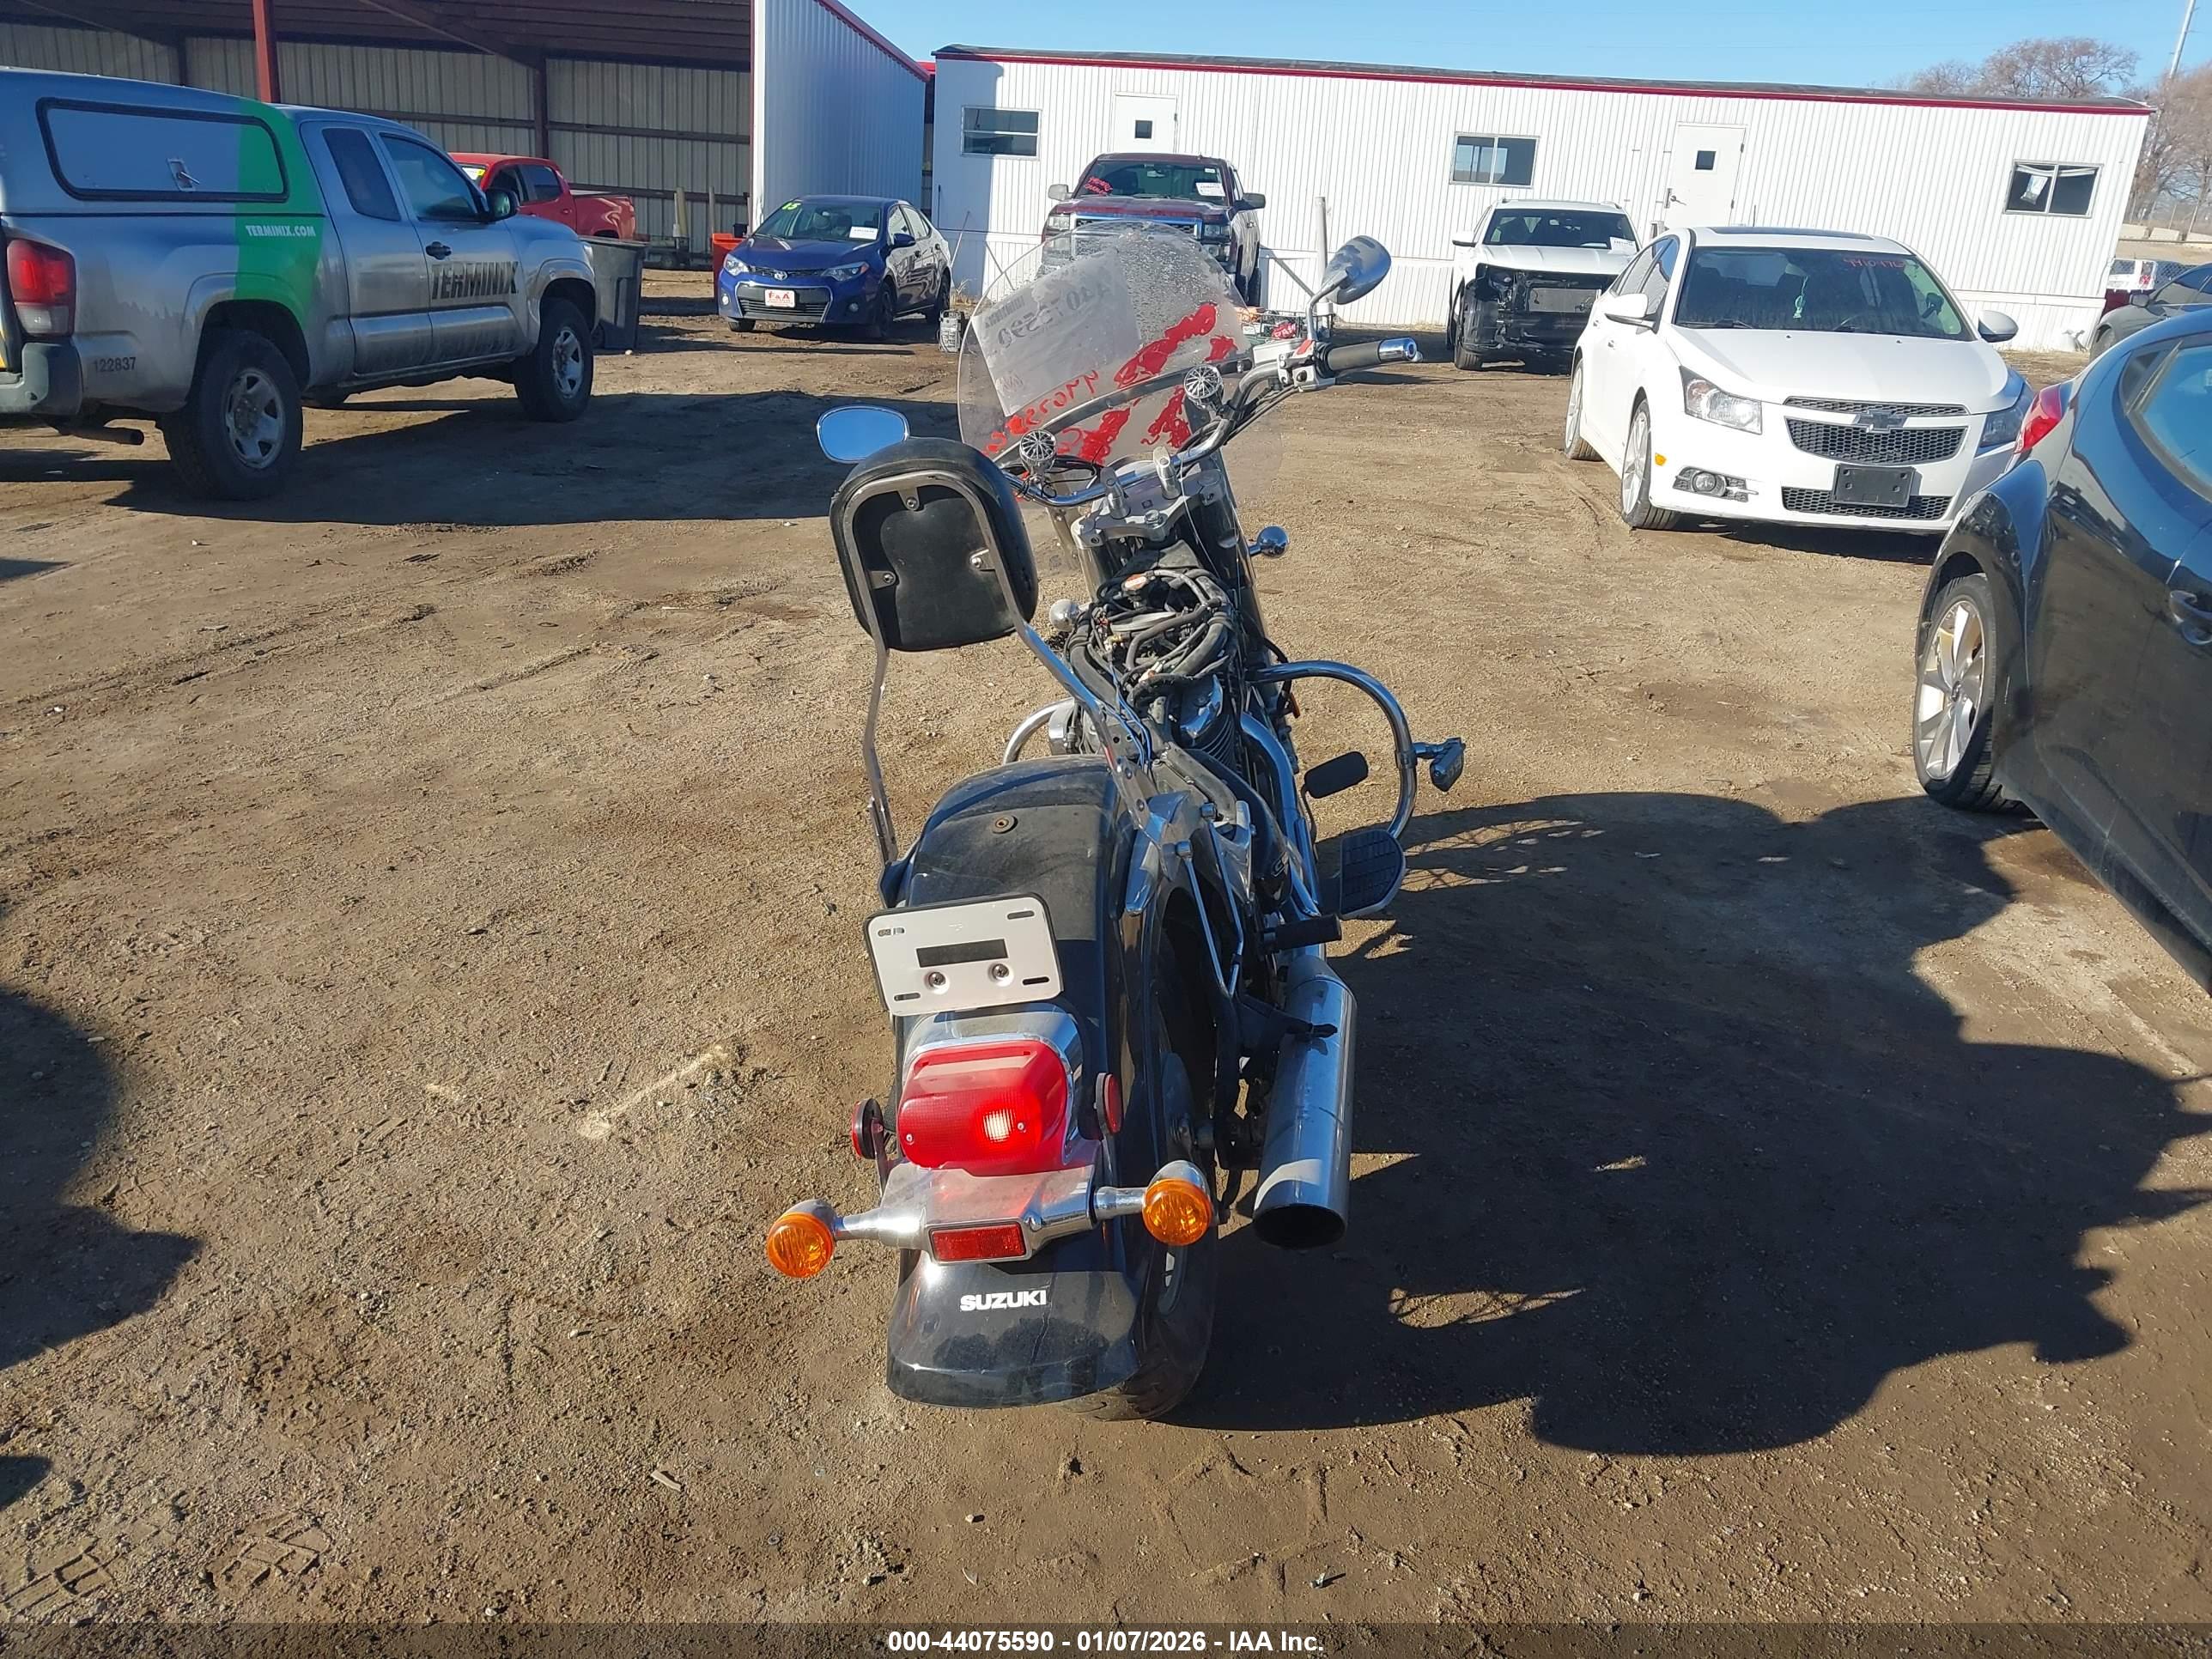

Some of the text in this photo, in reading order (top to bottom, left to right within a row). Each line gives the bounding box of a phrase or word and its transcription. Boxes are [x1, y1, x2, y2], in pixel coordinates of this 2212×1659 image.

[245, 224, 317, 237] TERMINIX.COM
[431, 261, 520, 300] TERMINIX
[93, 356, 137, 373] 122837
[959, 1289, 1047, 1312] SUZUKI
